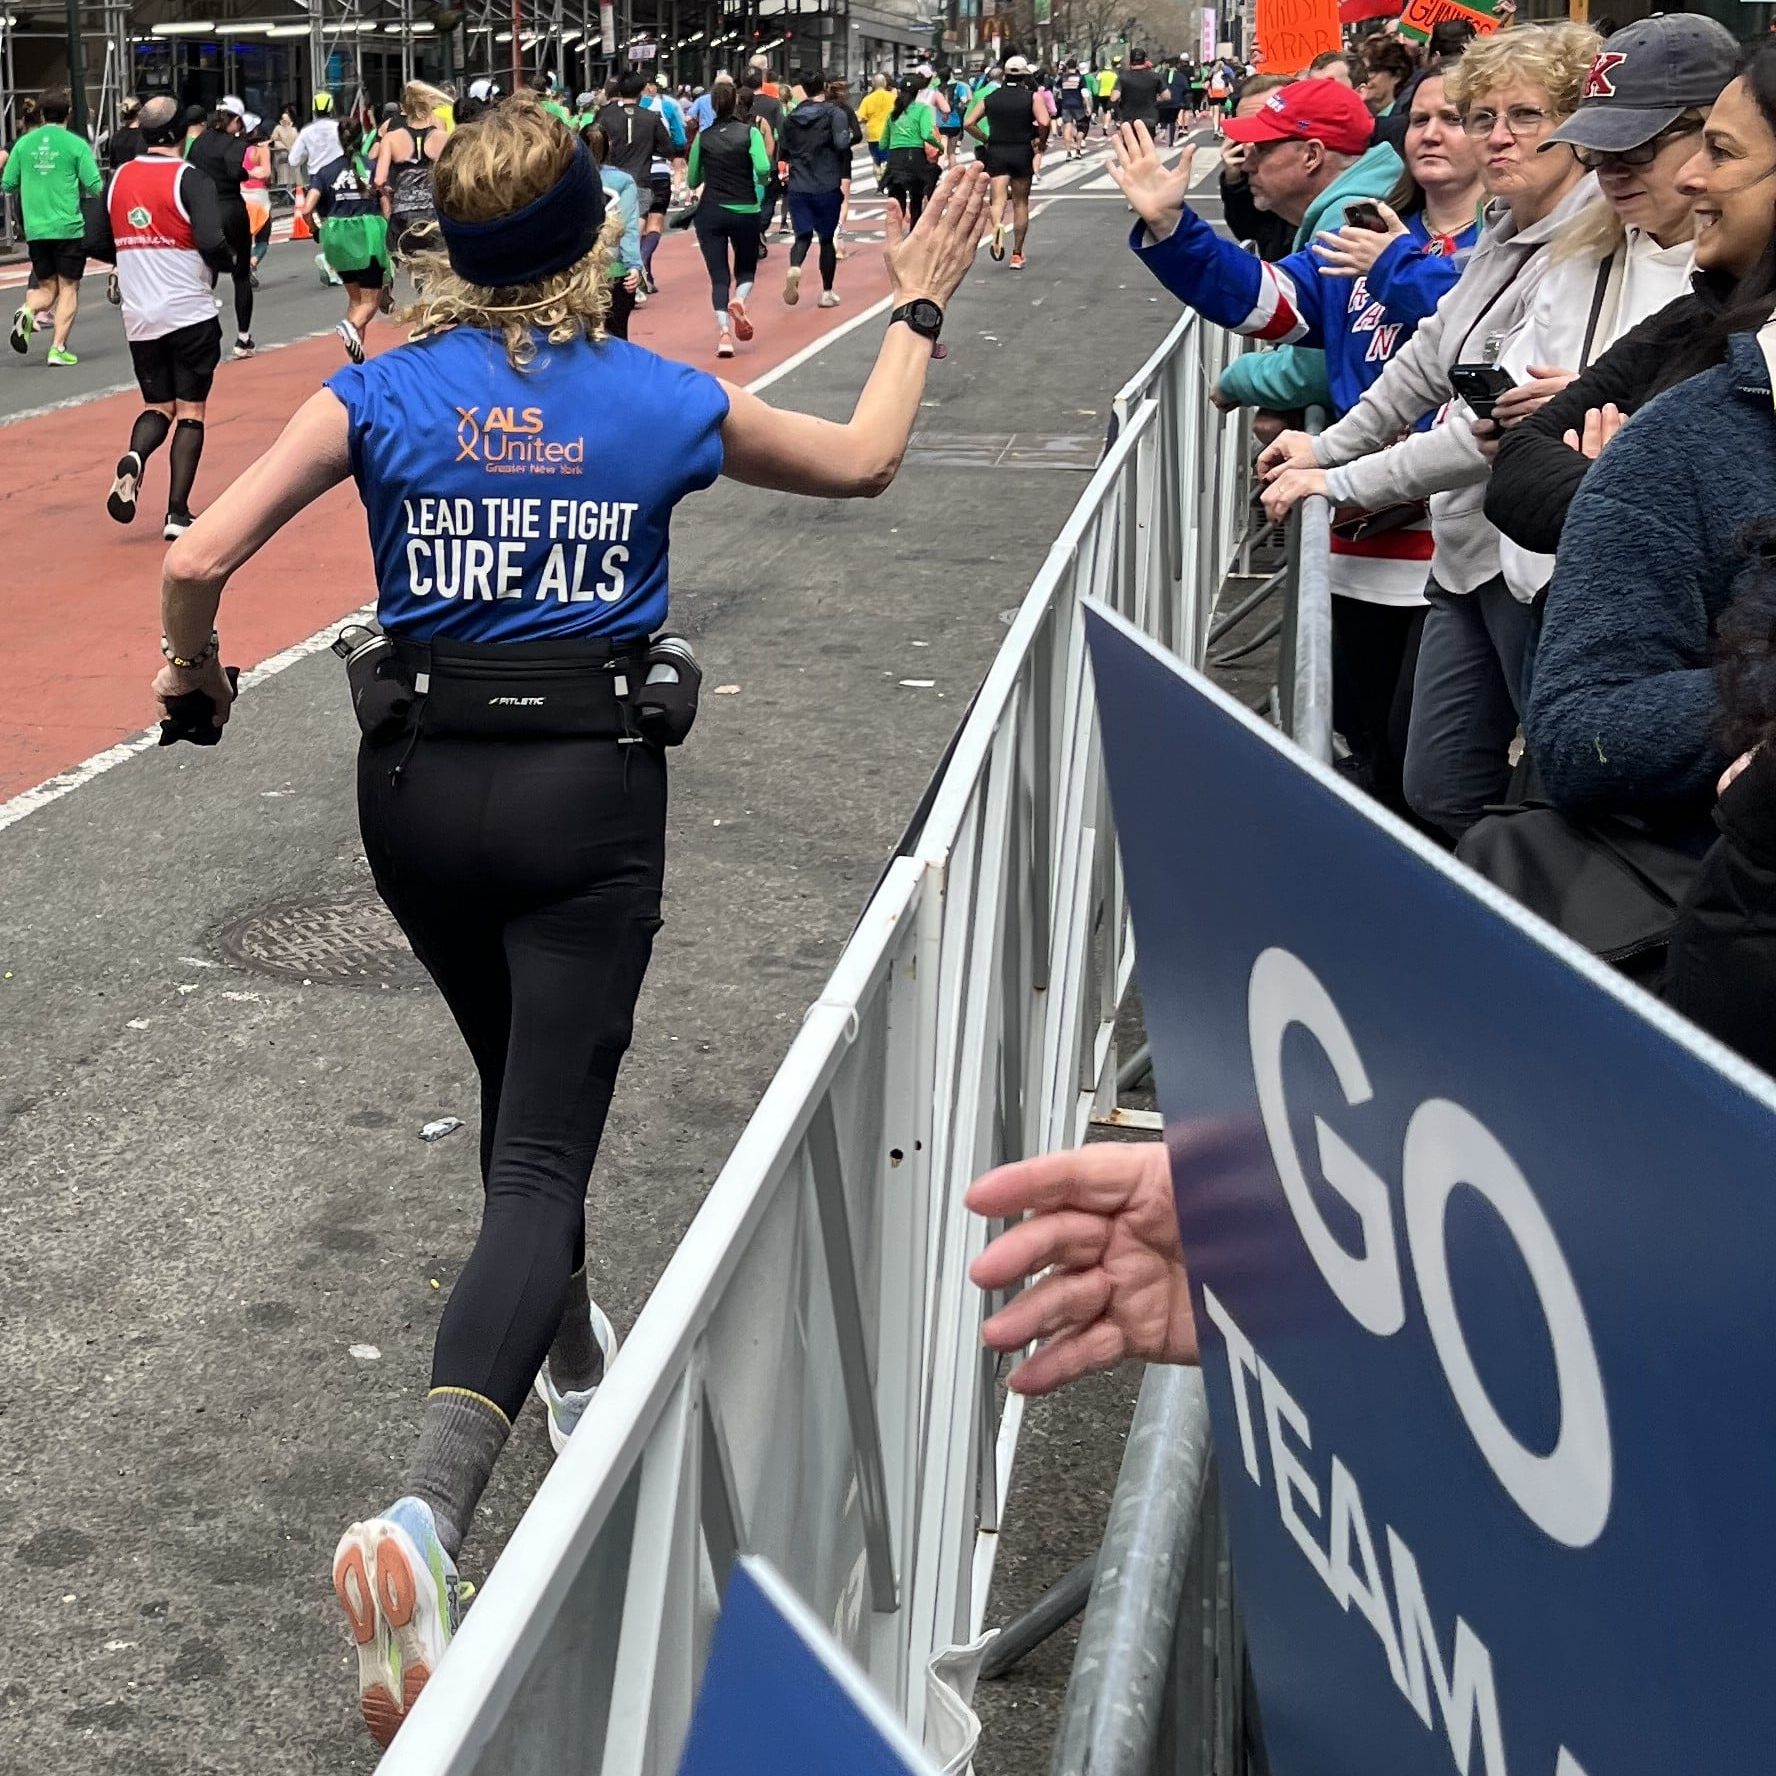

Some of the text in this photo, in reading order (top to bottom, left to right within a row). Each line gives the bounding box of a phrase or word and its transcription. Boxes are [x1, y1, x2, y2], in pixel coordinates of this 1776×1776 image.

[1583, 51, 1628, 98] K
[482, 406, 544, 433] ALS
[484, 434, 584, 463] United
[485, 462, 583, 475] Greater New York
[403, 498, 639, 541] LEAD THE FIGHT
[406, 538, 630, 603] CURE ALS
[499, 697, 547, 706] FITLETIC
[1248, 946, 1613, 1548] GO
[1203, 1282, 1508, 1776] TEAM
